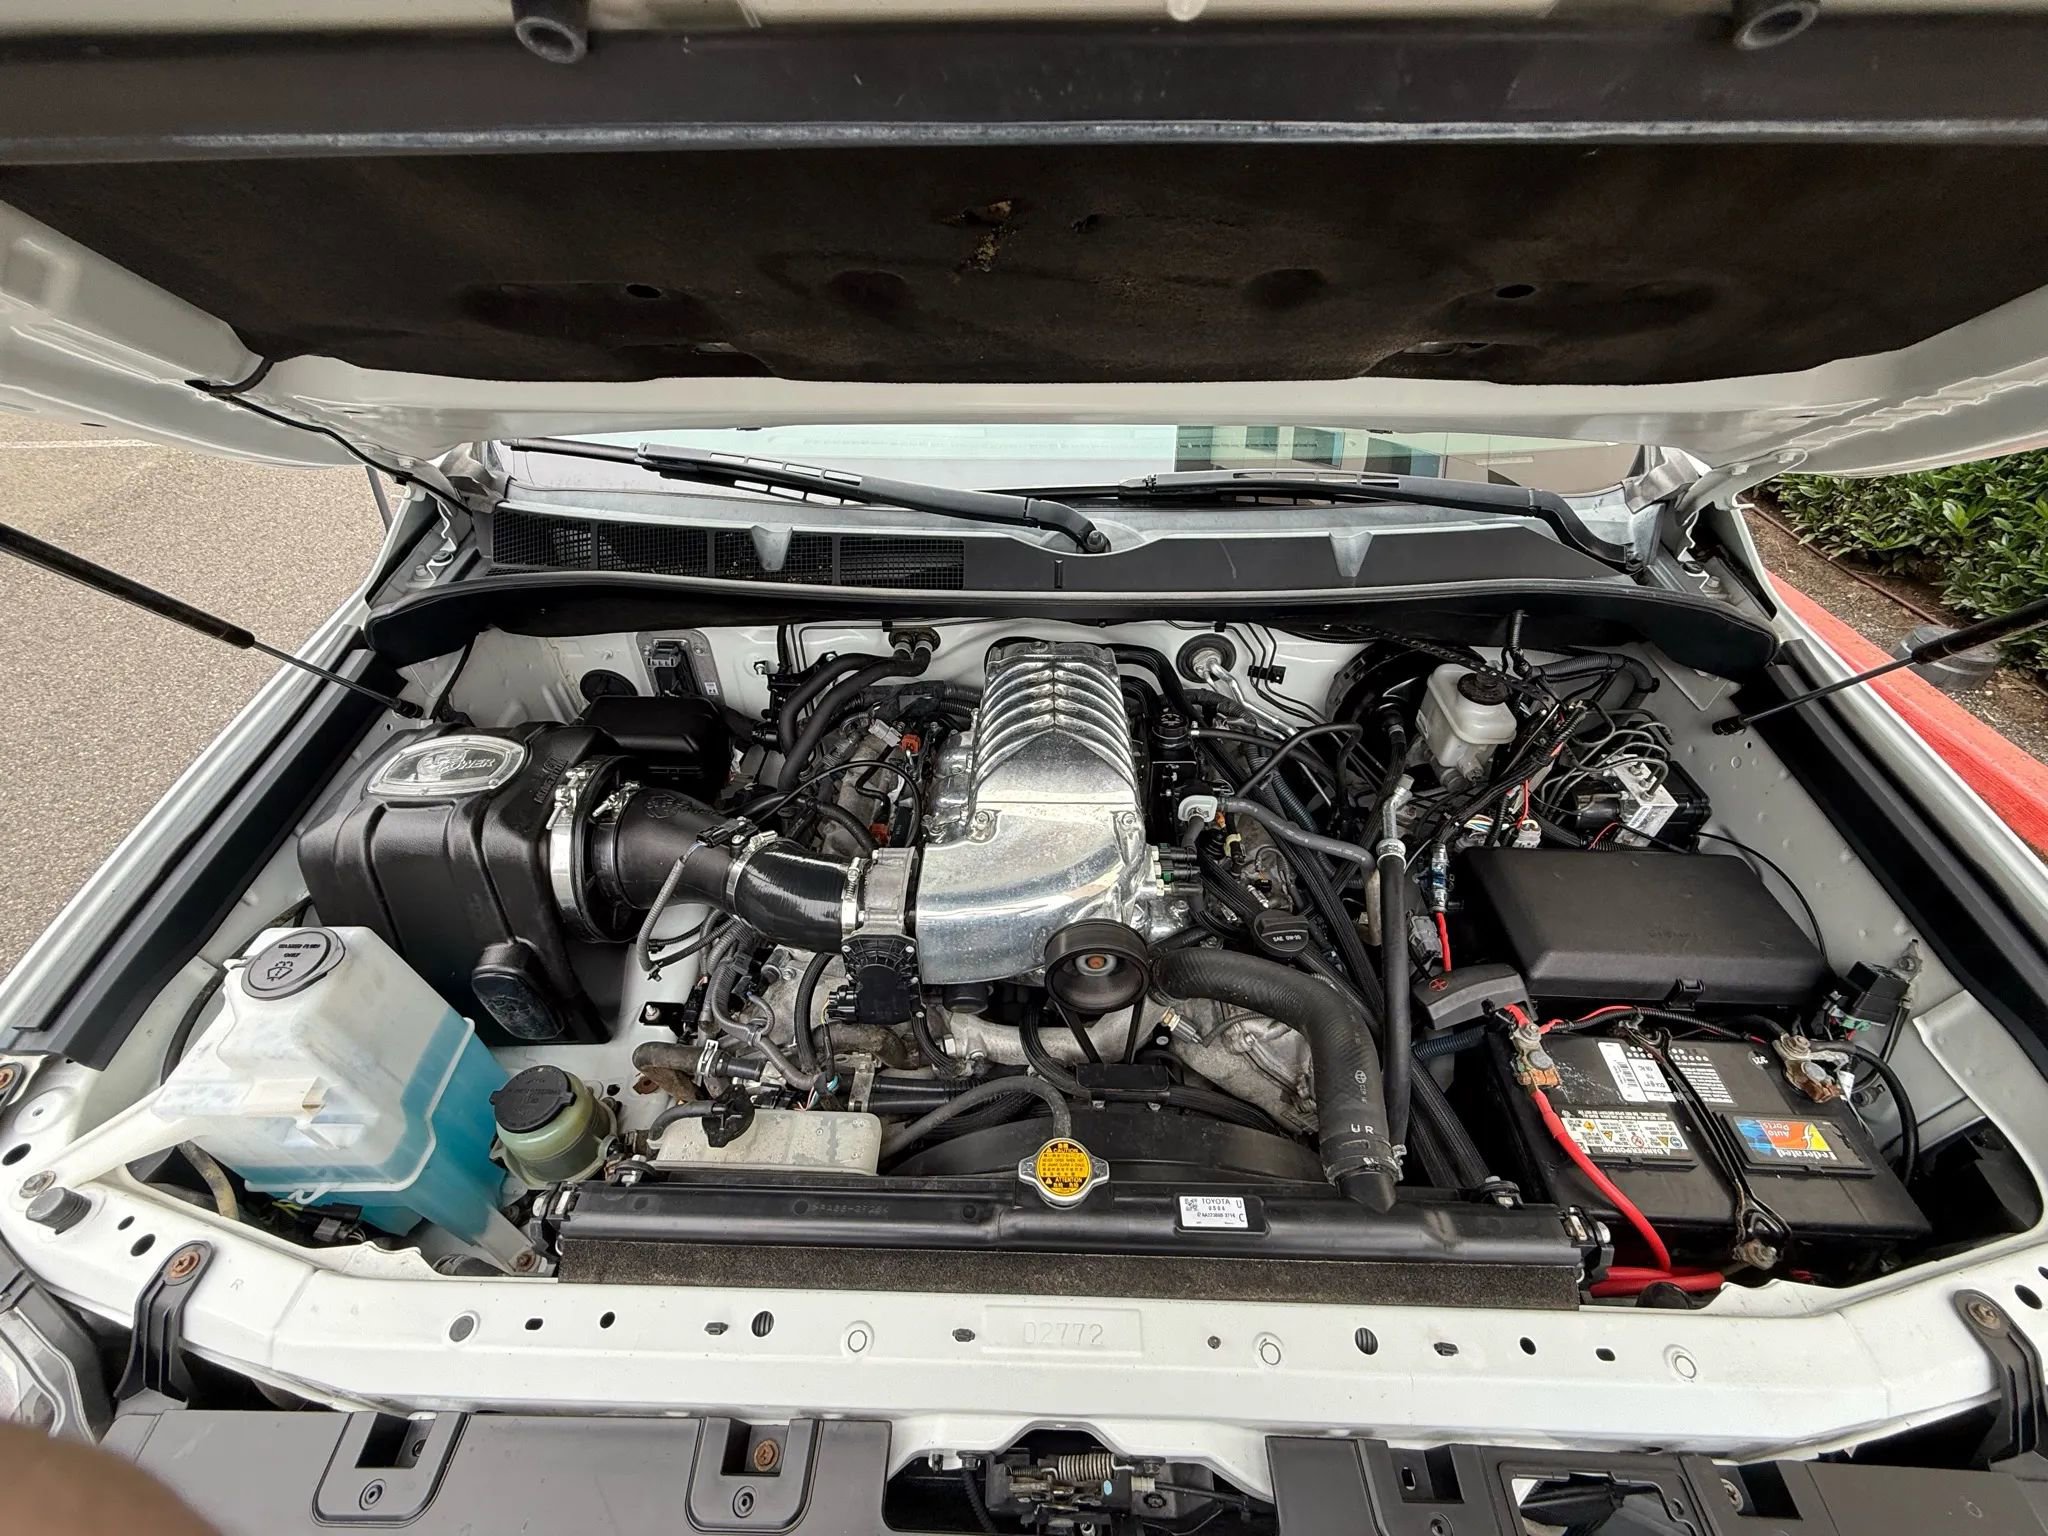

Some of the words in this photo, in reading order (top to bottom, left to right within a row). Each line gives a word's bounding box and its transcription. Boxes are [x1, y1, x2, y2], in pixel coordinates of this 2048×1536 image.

[1762, 1122, 1790, 1131] Parts
[1767, 1129, 1790, 1138] Auto
[1775, 1148, 1838, 1160] Federated
[1235, 1199, 1243, 1209] U
[1238, 1213, 1246, 1223] C
[1023, 1321, 1106, 1347] 02772
